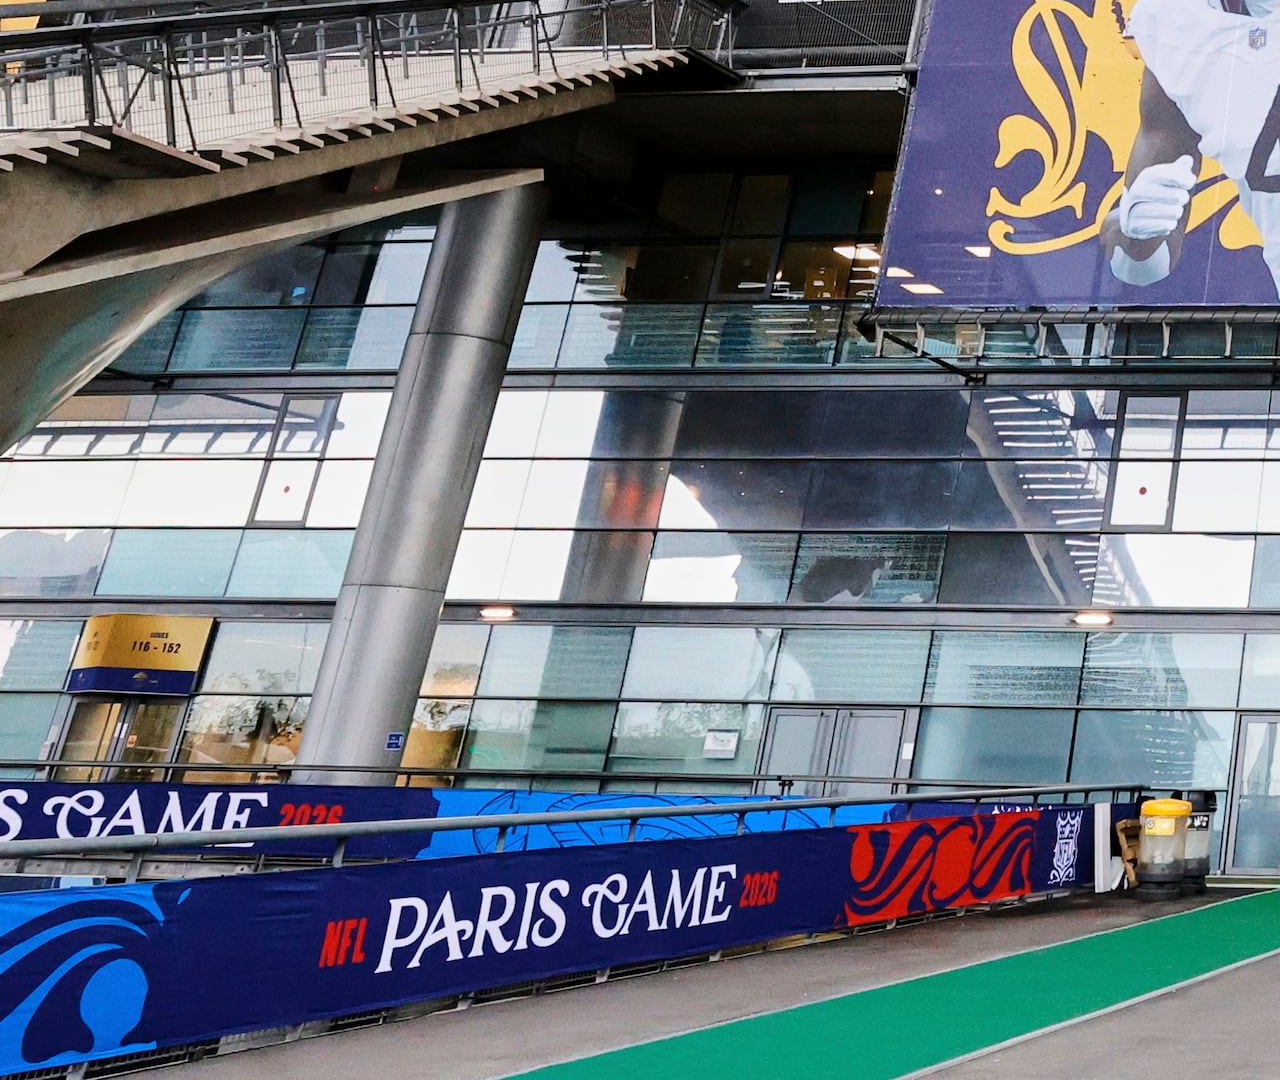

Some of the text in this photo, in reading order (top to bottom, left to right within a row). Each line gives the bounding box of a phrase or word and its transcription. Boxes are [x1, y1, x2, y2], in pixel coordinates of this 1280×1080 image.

[43, 788, 268, 848] GAME
[319, 864, 780, 974] NFL PARIS GAME 2026
